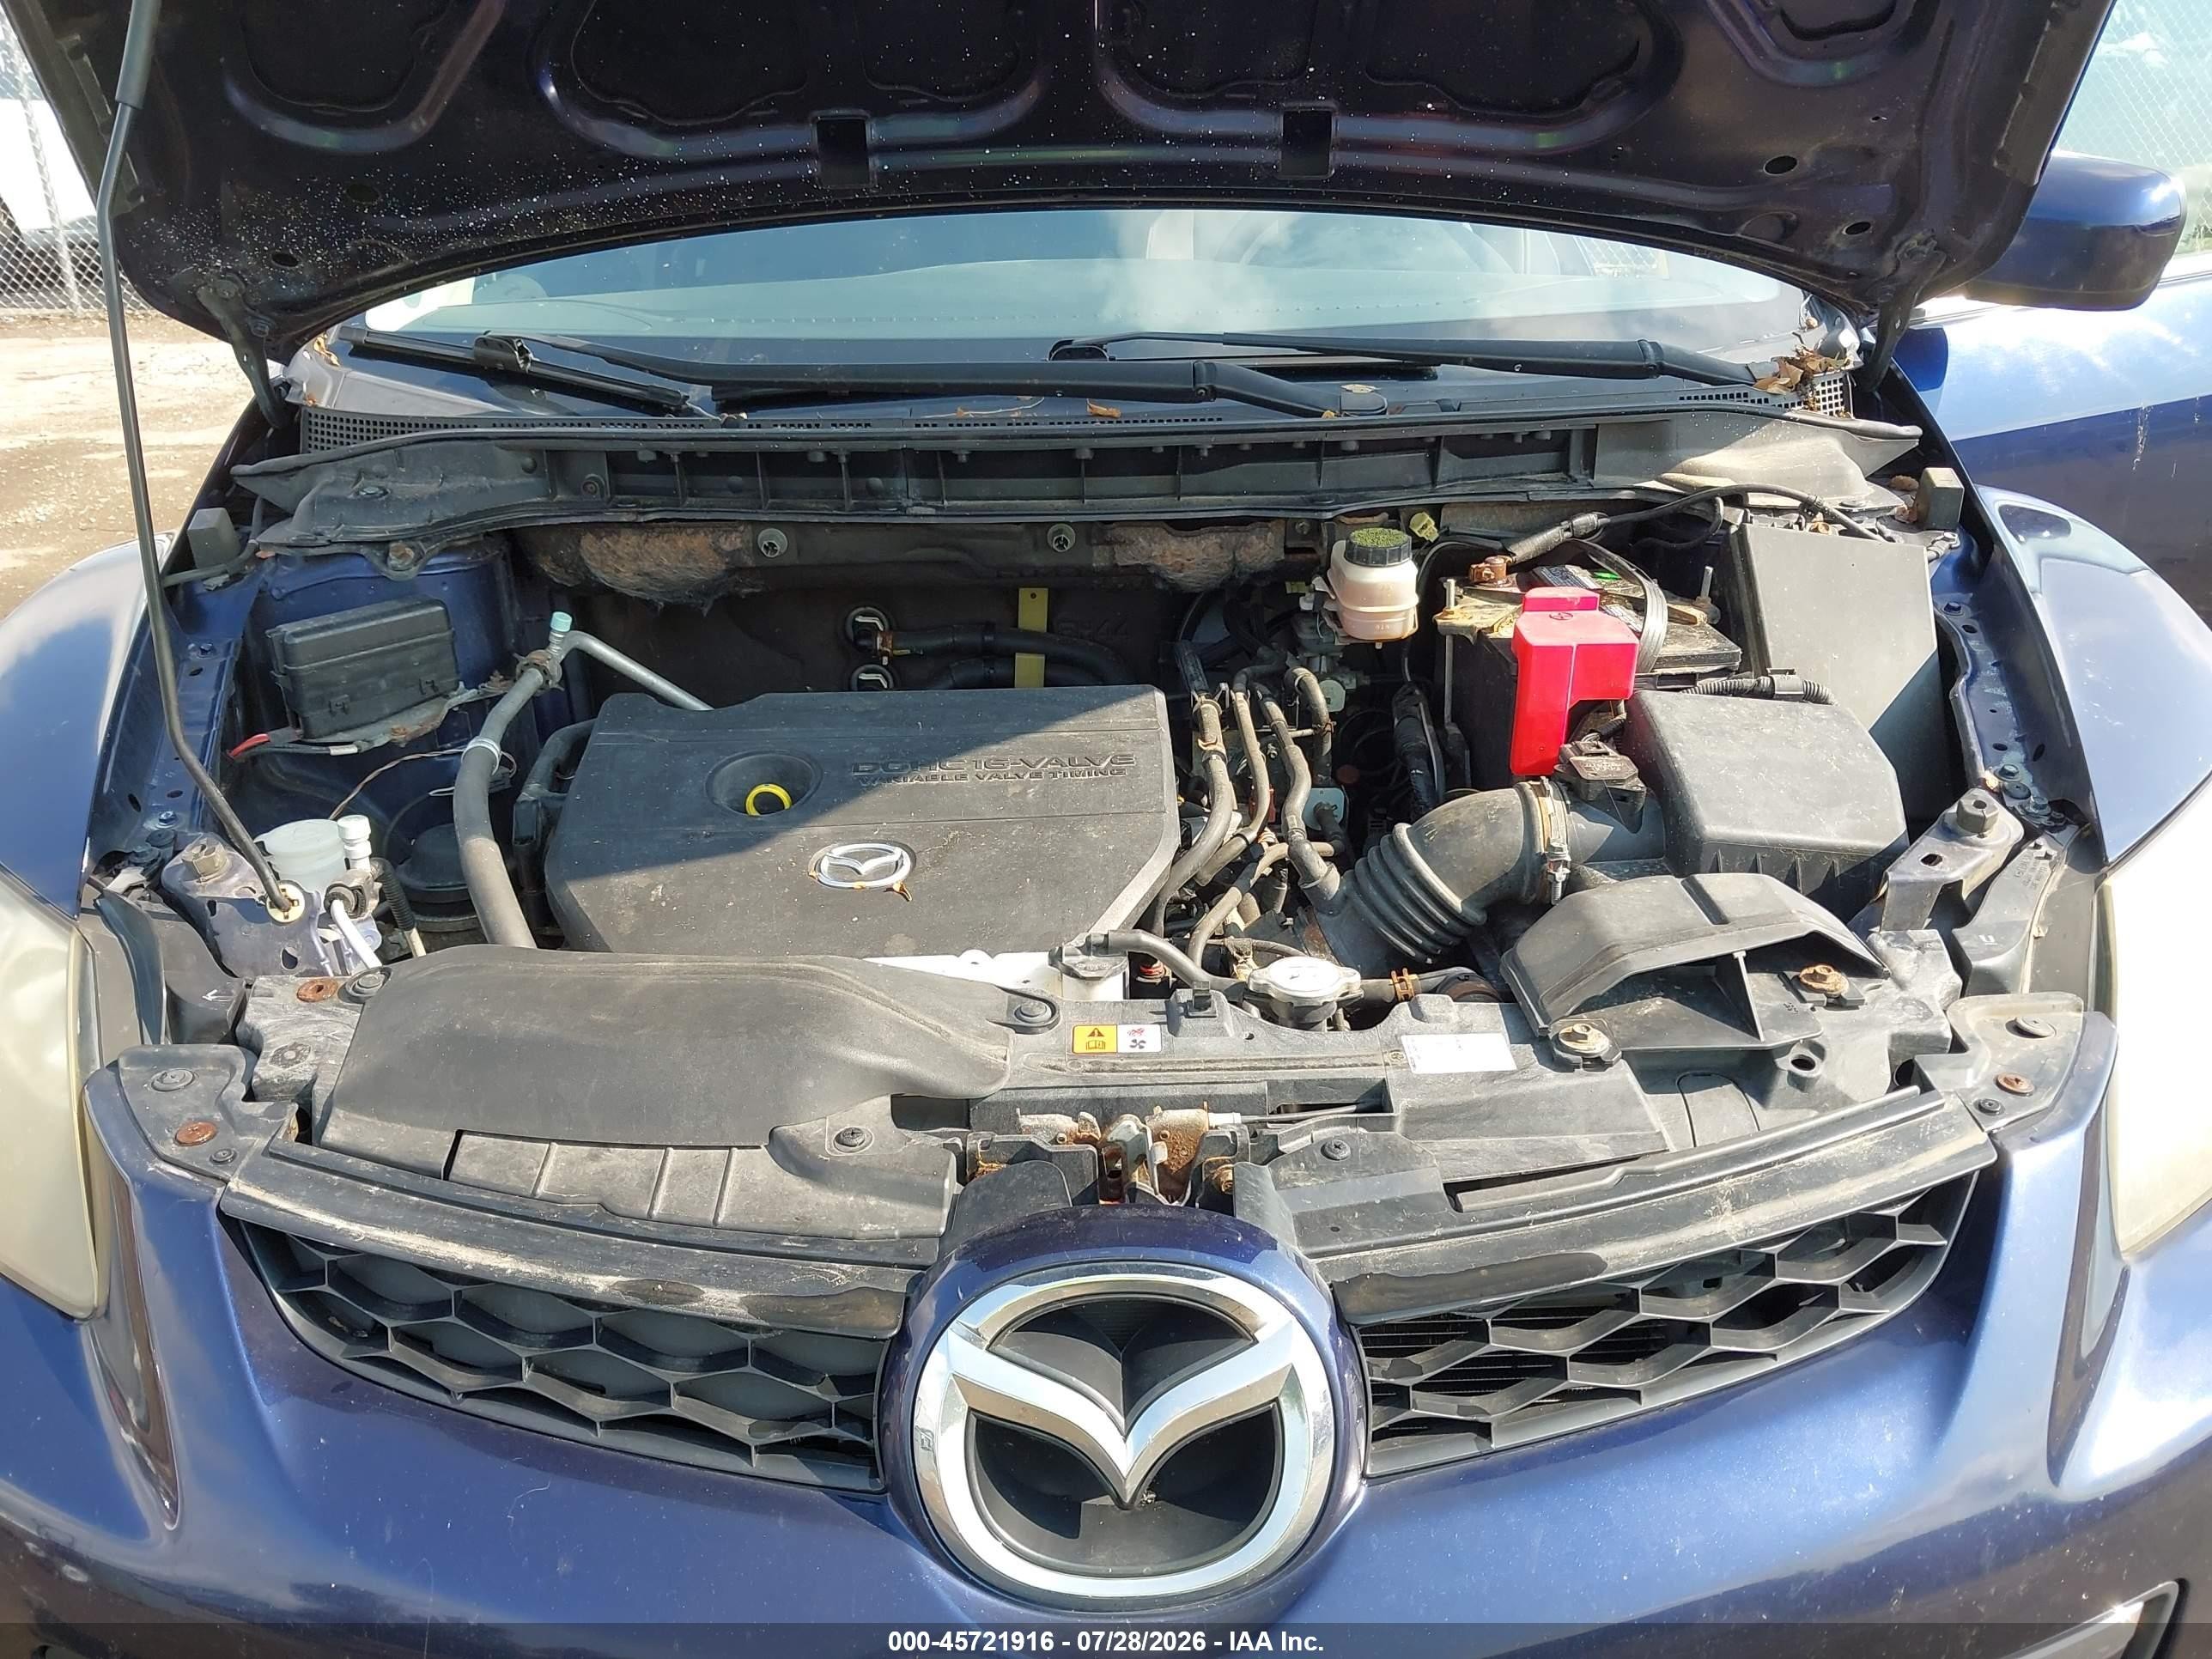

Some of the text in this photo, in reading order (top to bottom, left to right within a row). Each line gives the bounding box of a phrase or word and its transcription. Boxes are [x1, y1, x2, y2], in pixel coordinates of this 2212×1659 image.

[852, 752, 1135, 775] DOHC 16-VALVE
[975, 770, 1043, 781] VALVE
[1048, 768, 1127, 780] TIMING
